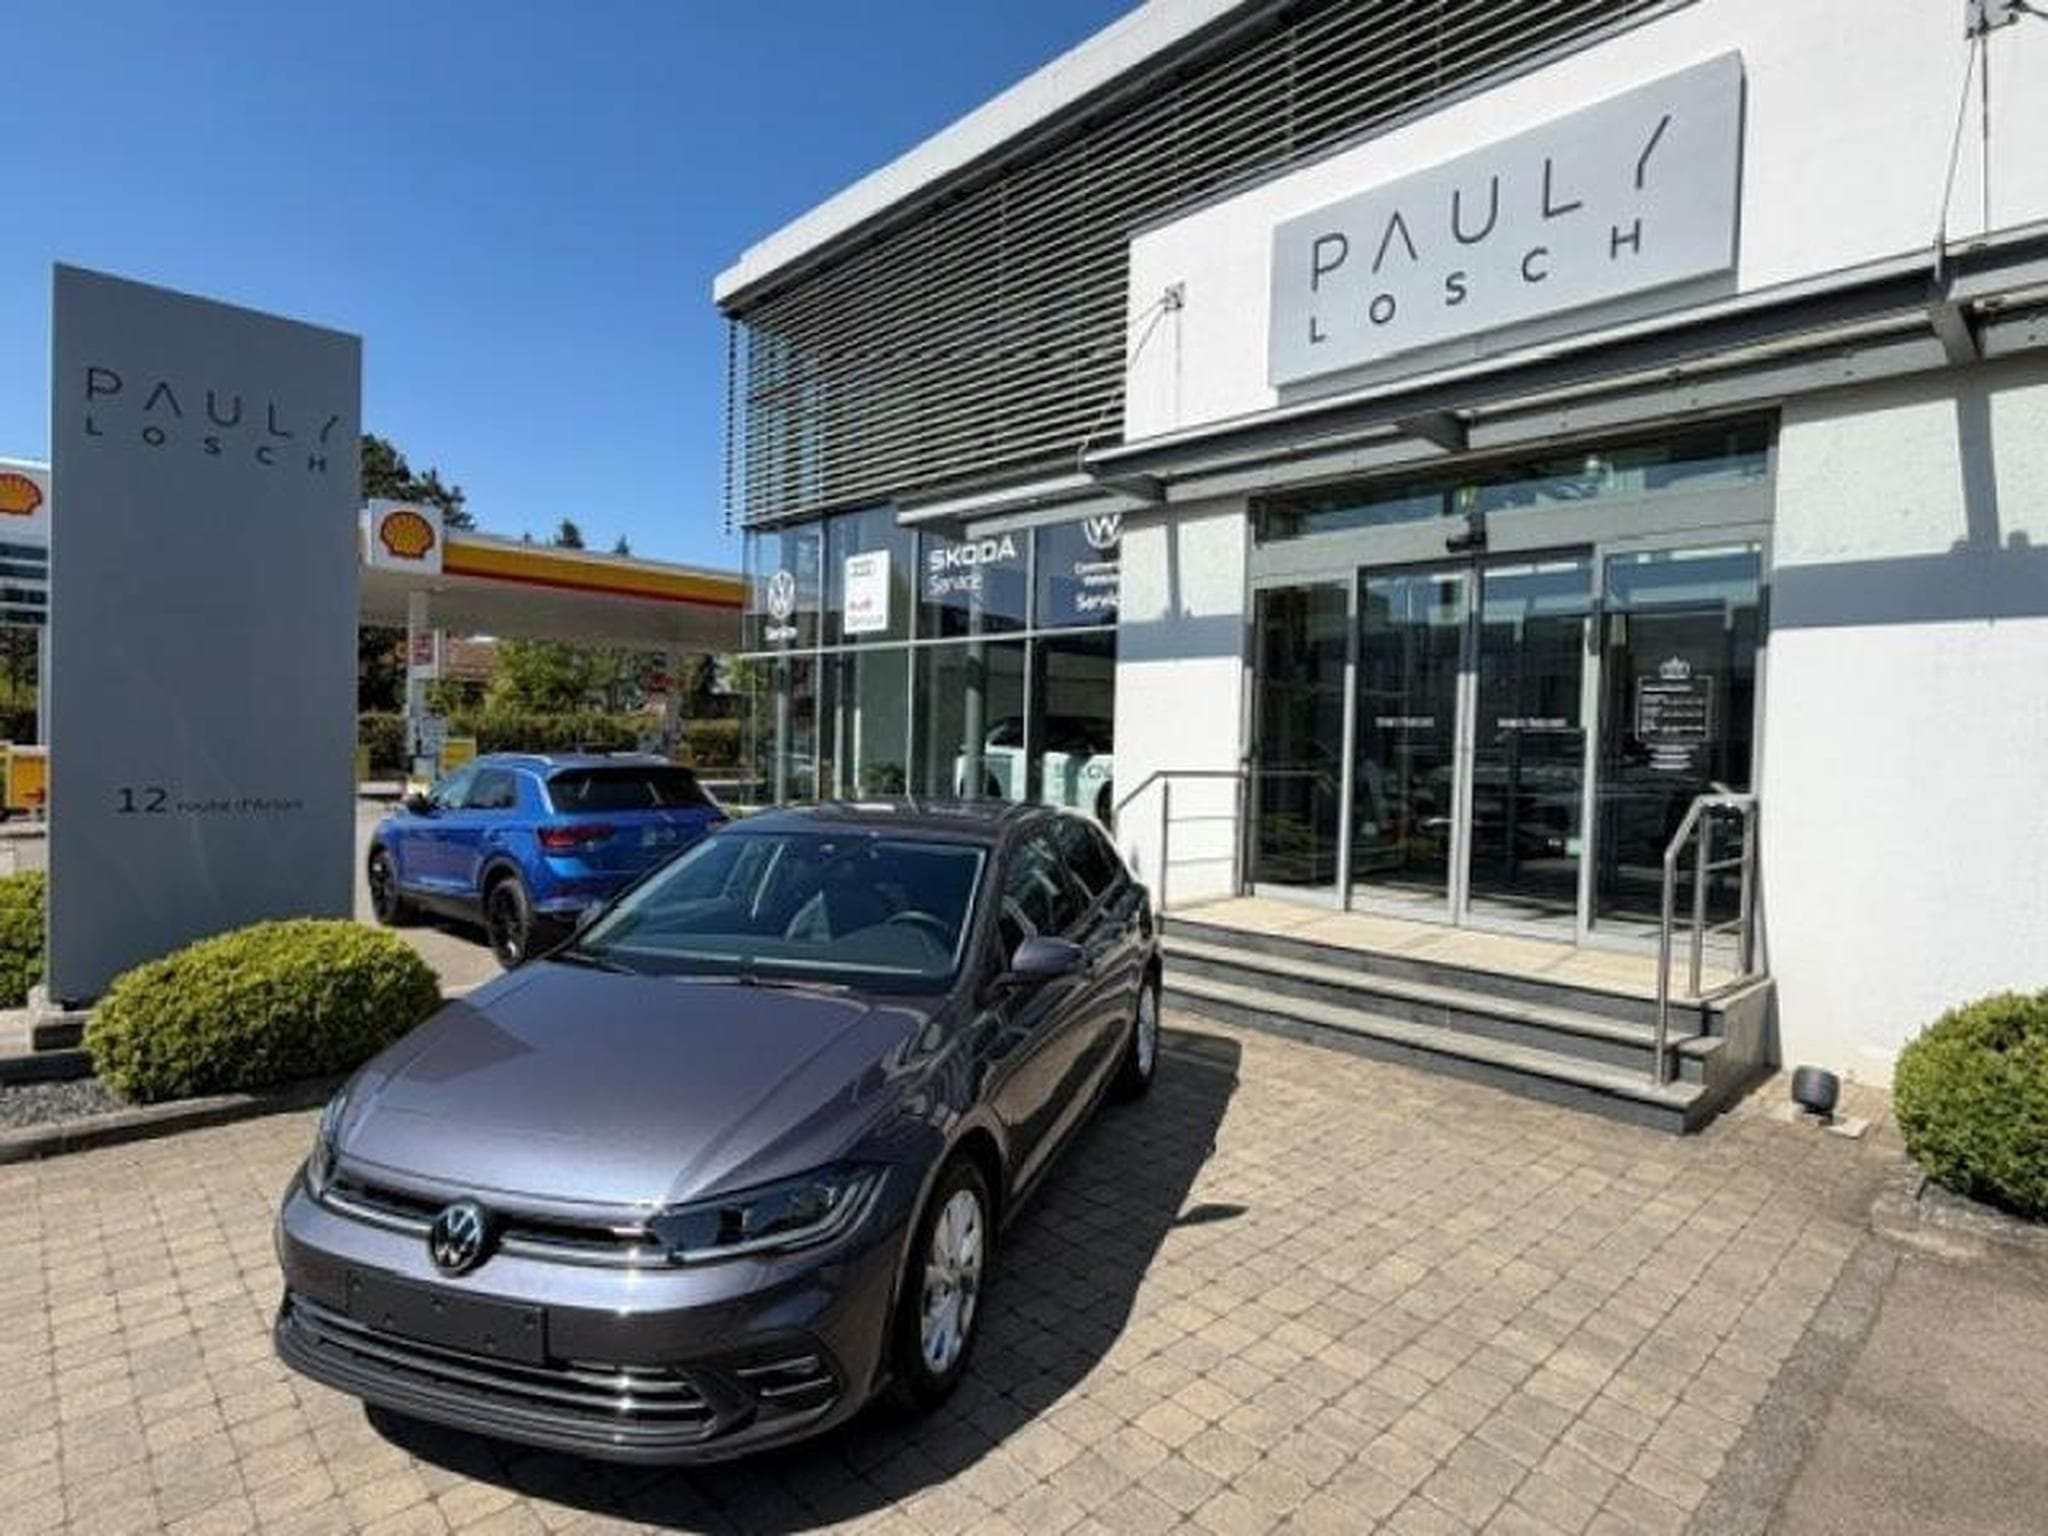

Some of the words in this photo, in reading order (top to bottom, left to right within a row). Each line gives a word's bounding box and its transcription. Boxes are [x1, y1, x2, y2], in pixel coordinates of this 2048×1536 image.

[1309, 217, 1642, 344] LOSCH
[85, 417, 328, 473] LOSCH
[117, 787, 168, 814] 12
